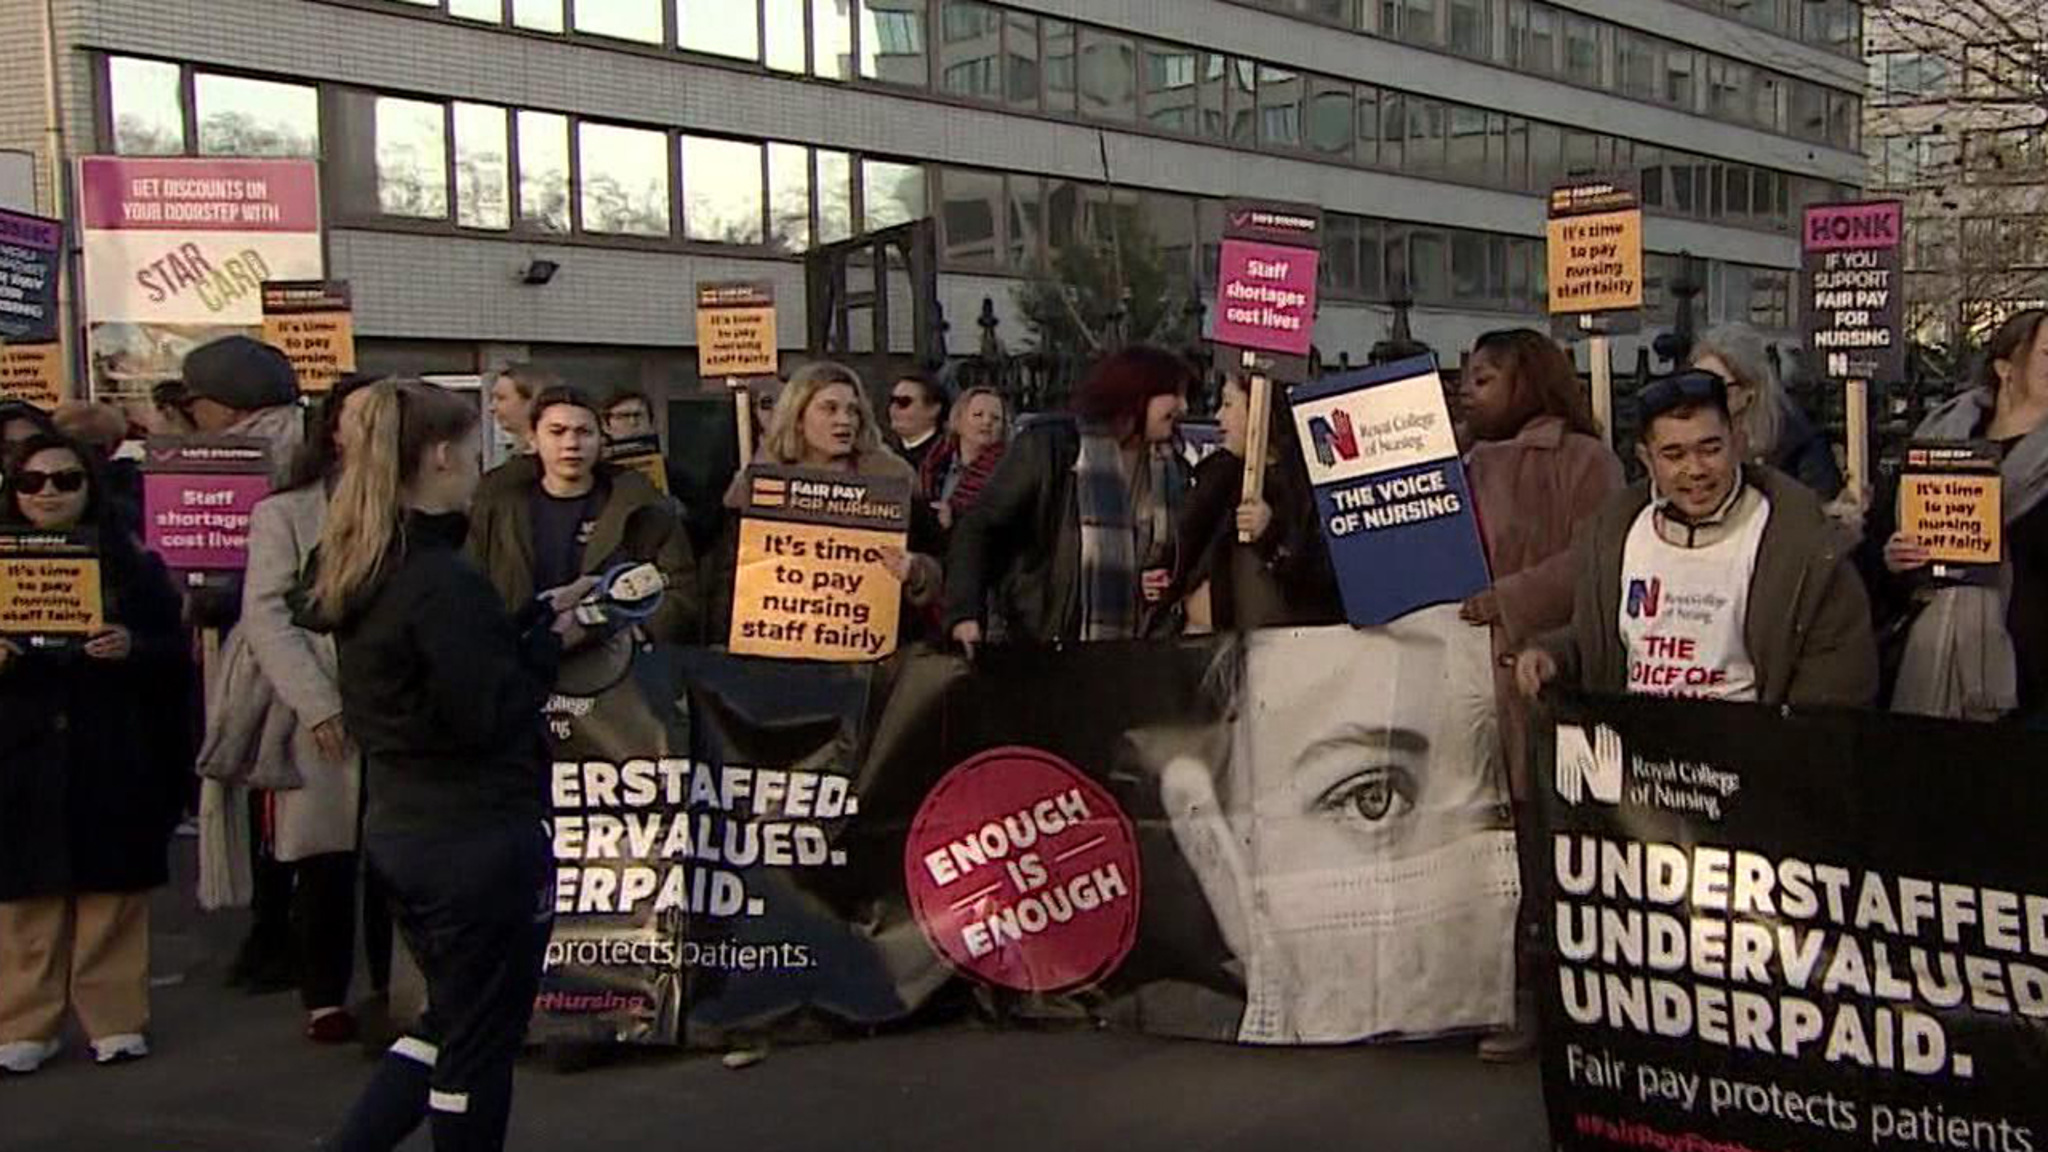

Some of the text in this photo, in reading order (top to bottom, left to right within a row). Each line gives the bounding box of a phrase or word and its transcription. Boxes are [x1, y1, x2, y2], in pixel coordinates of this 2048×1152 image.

[133, 179, 267, 199] GET DISCOUNTS ON
[123, 202, 280, 222] YOUR DOORSTEP WITH
[1562, 222, 1624, 240] It's time
[1811, 213, 1892, 240] HONK
[1570, 244, 1617, 259] to pay
[1825, 252, 1878, 268] IF YOU
[136, 242, 213, 303] STAR
[1247, 260, 1288, 280] Staff
[1566, 261, 1623, 278] nursing
[1814, 270, 1889, 288] SUPPORT
[196, 249, 270, 312] CARD
[1557, 279, 1633, 298] staff fairly
[1226, 280, 1306, 308] shortages
[1815, 290, 1888, 308] FAIR PAY
[1226, 308, 1300, 330] cost lives
[1834, 311, 1869, 326] FOR
[1814, 329, 1890, 347] NURSING
[182, 490, 235, 505] Staff
[791, 481, 866, 499] FAIR PAY
[1331, 471, 1446, 511] THE VOICE
[1917, 482, 1983, 496] It's time
[791, 499, 901, 519] FOR NURSING
[1330, 493, 1460, 536] OF NURSING
[1925, 501, 1975, 516] to pay
[155, 510, 249, 529] shortage
[1919, 519, 1981, 533] nursing
[161, 531, 250, 548] cost live
[765, 535, 805, 556] It's
[1950, 535, 1992, 552] fairly
[776, 565, 863, 594] to pay
[763, 595, 870, 624] nursing
[742, 620, 885, 654] staff fairly
[1643, 636, 1695, 659] THE
[1685, 667, 1727, 686] OF
[1631, 754, 1740, 797] Royal College
[552, 758, 858, 818] ERSTAFFED.
[1630, 782, 1721, 820] of Nursing
[553, 812, 847, 866] ERVALUED.
[924, 788, 1091, 887] ENOUGH
[1006, 853, 1048, 894] IS
[555, 864, 764, 916] ERPAID.
[961, 863, 1128, 959] ENOUGH
[542, 935, 818, 973] protects patients.
[1555, 901, 2048, 1018] UNDERVALUED
[1559, 965, 1974, 1078] UNDERPAID.
[1566, 1042, 1625, 1090] Fair
[1638, 1065, 1699, 1111] pay
[1710, 1077, 1857, 1132] protects
